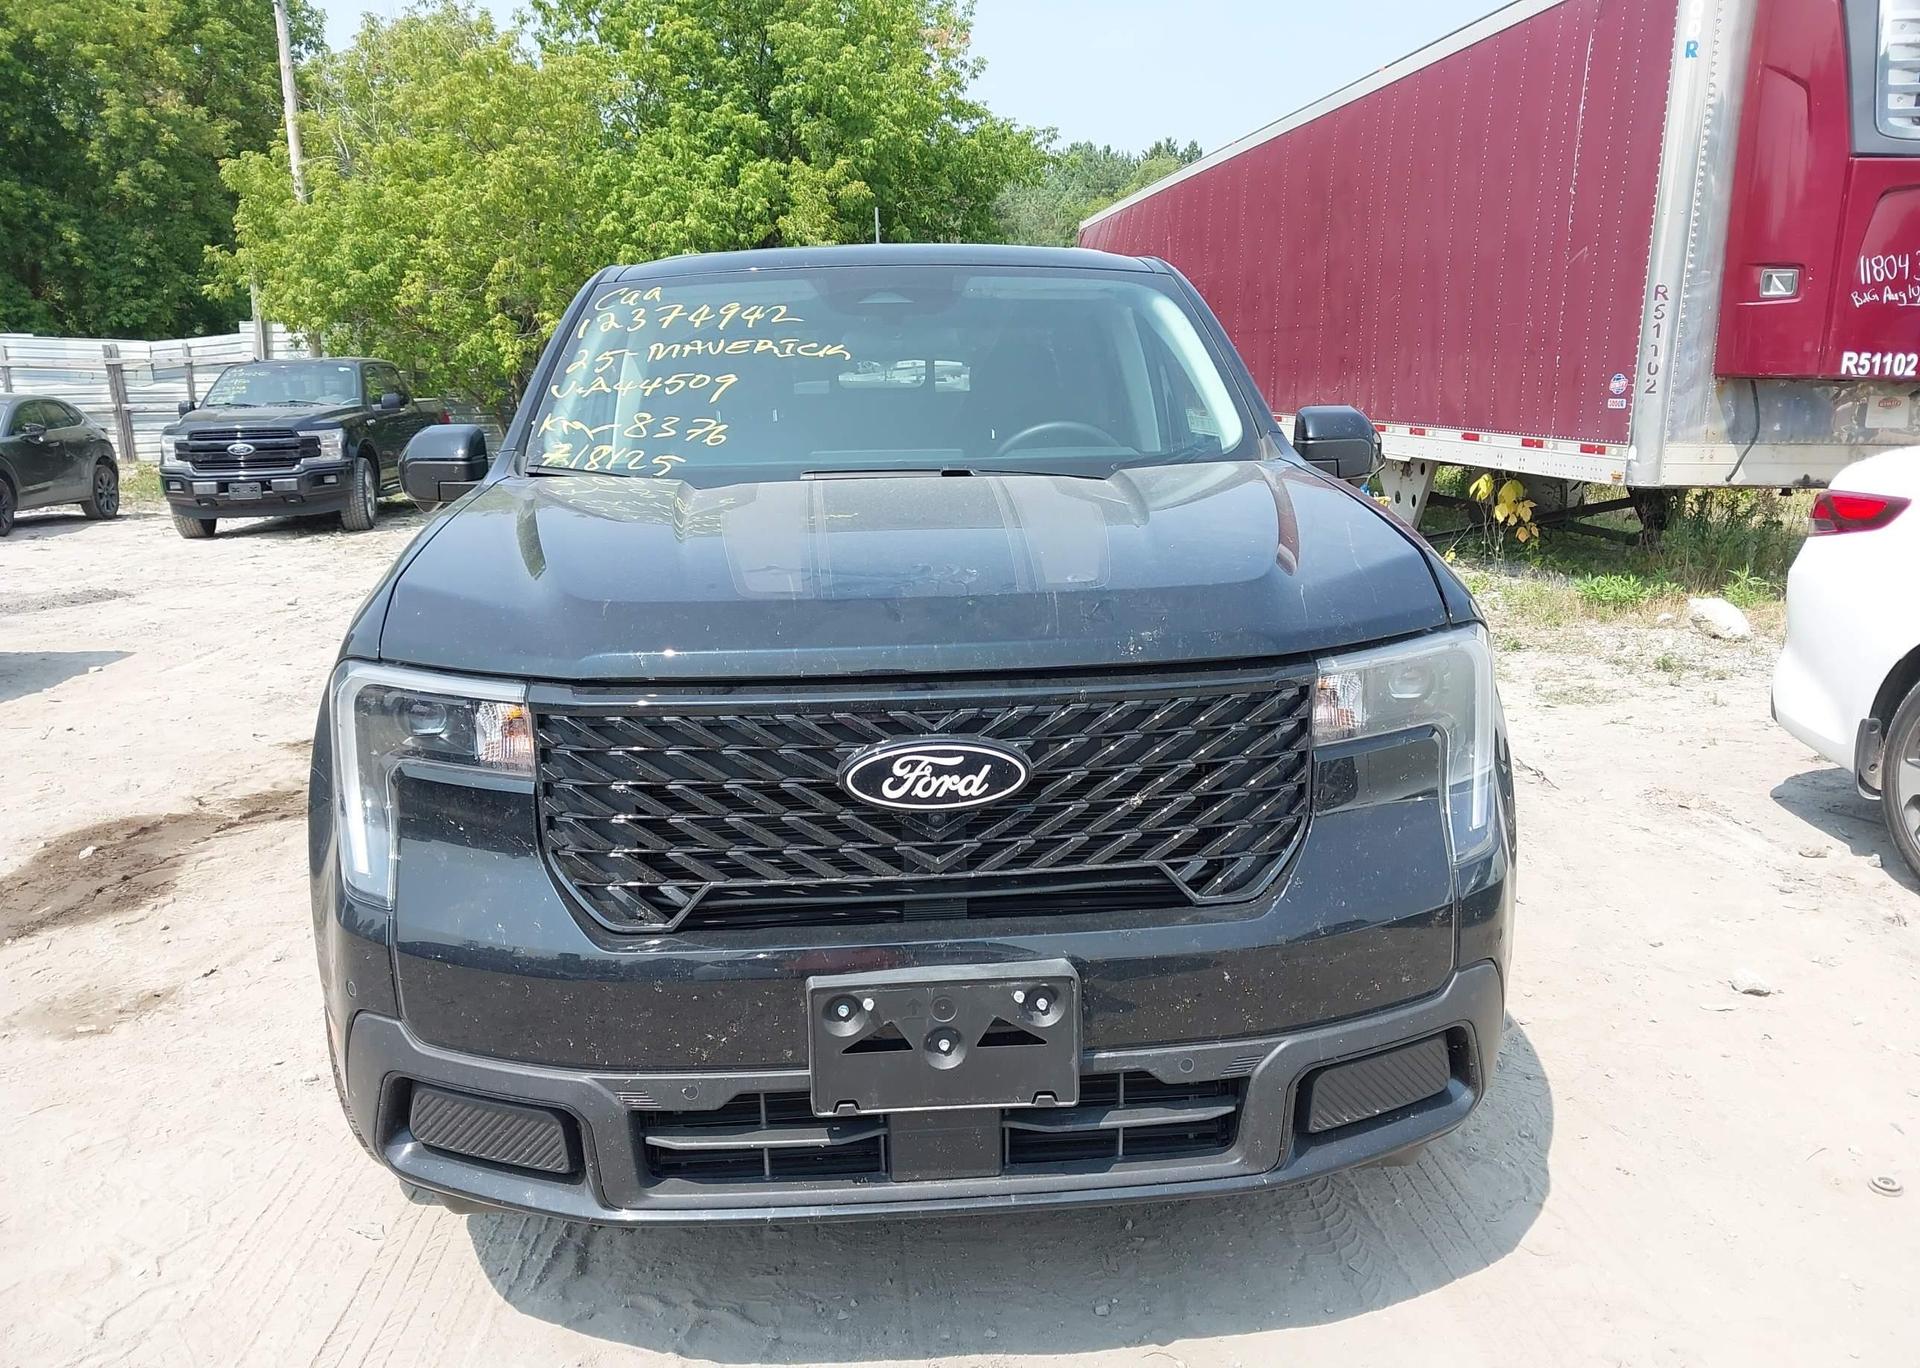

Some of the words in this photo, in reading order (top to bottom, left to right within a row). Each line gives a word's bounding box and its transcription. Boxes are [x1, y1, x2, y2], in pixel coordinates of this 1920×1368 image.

[577, 302, 804, 339] 12374942
[1645, 284, 1669, 394] R51102
[1841, 351, 1918, 377] R51102
[881, 755, 991, 799] Ford
